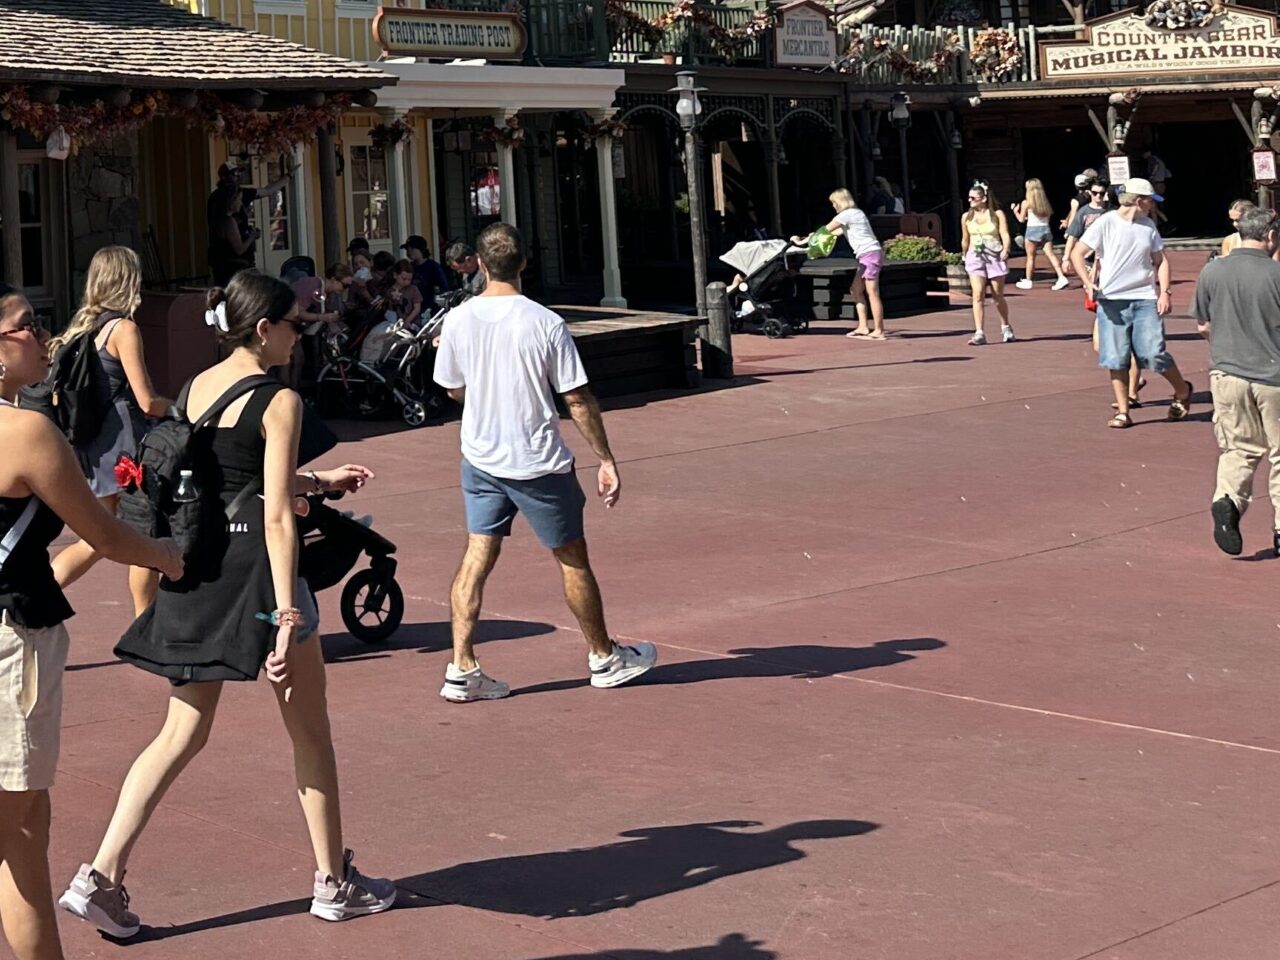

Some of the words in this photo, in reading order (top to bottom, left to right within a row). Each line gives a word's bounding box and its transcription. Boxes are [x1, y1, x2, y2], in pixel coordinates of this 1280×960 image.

[388, 21, 440, 45] FRONTIER
[440, 23, 484, 47] TRADING
[486, 25, 511, 48] POST
[786, 18, 824, 37] FRONTIER
[1097, 31, 1200, 47] COUNTRY
[1208, 25, 1266, 43] BEAR
[782, 39, 830, 57] MERCANTILE
[1051, 48, 1168, 71] MUSICAL
